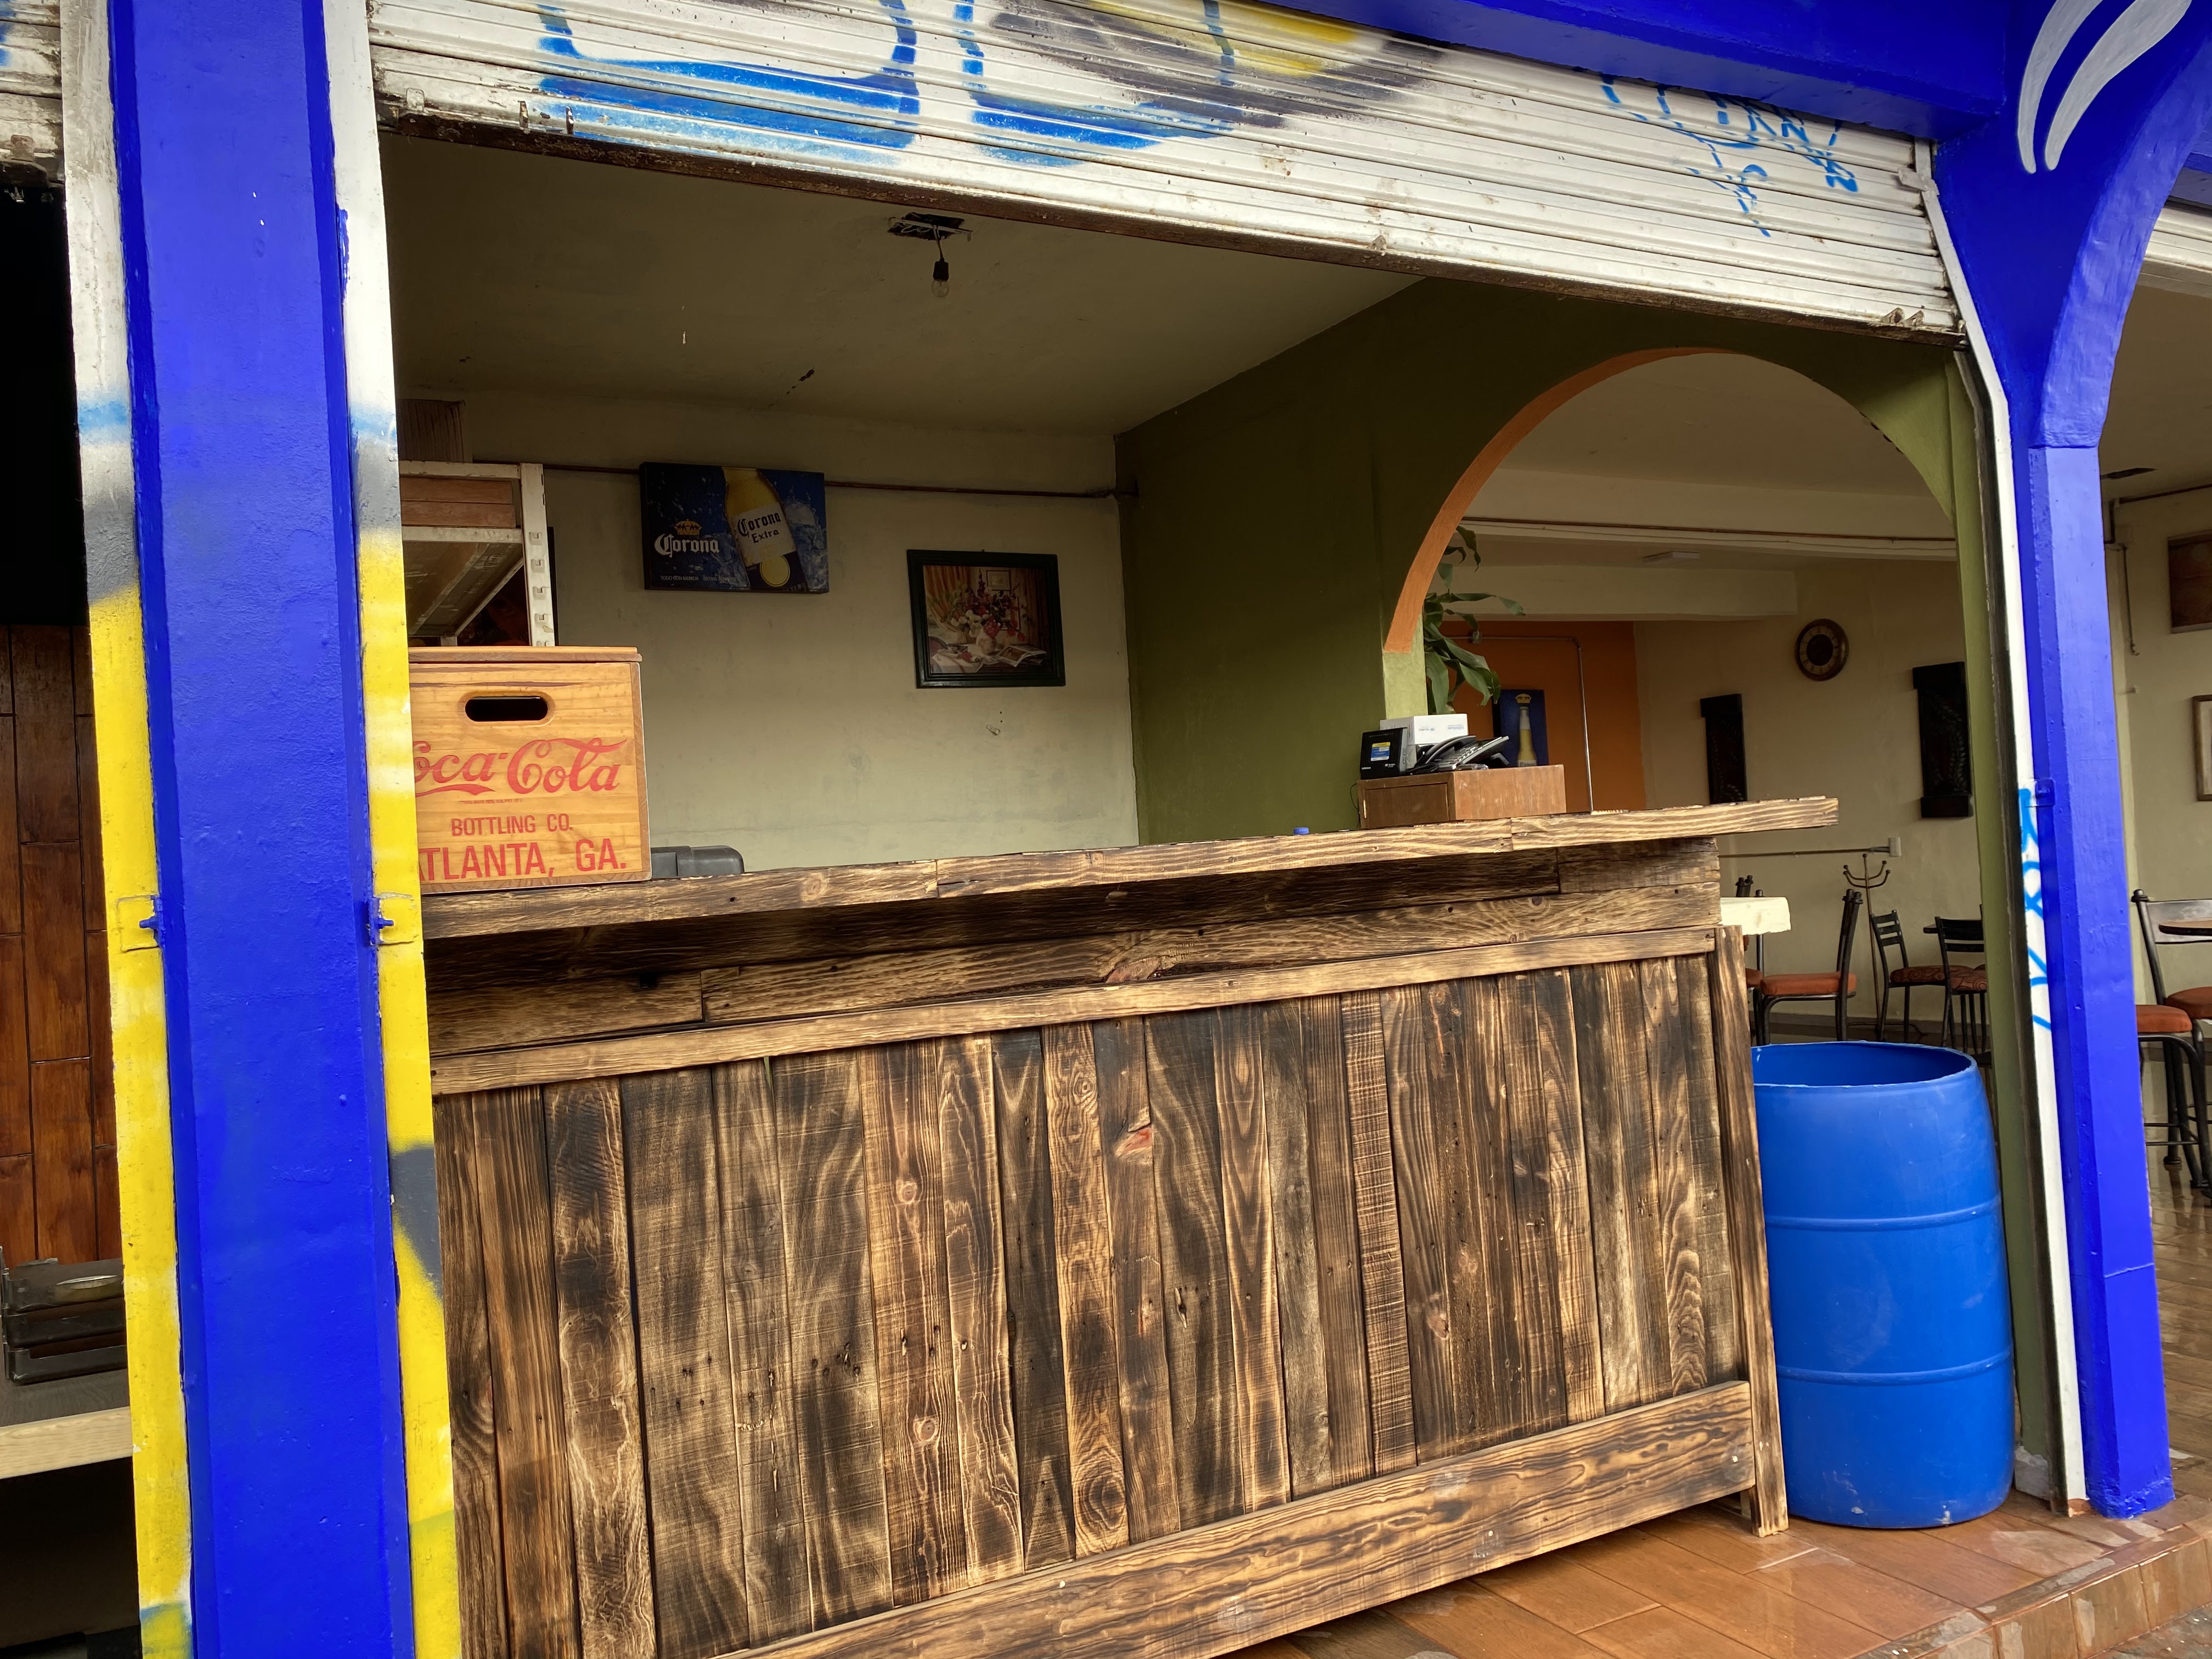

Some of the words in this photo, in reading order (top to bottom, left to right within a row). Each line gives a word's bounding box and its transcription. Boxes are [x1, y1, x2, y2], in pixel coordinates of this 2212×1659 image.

[737, 512, 781, 537] Corona
[752, 529, 780, 543] Extra
[654, 534, 720, 557] Corona
[414, 738, 627, 797] oca-Cola
[452, 815, 535, 836] BOTTLING
[547, 813, 573, 832] CO.
[419, 842, 555, 881] TLANTA,
[575, 838, 626, 871] GA.
